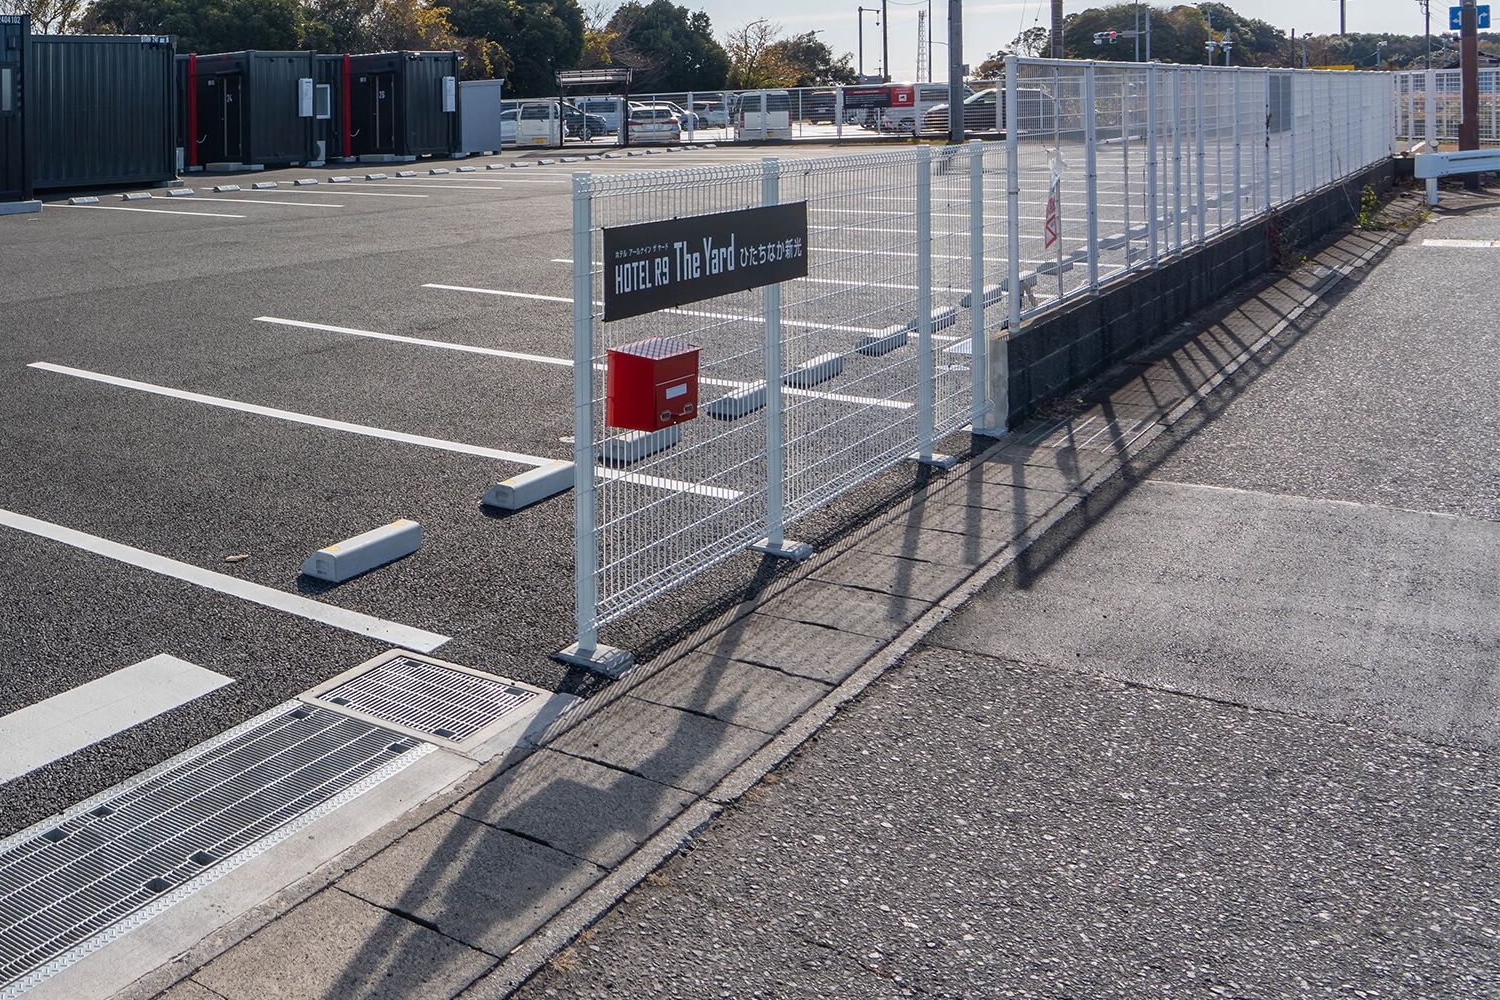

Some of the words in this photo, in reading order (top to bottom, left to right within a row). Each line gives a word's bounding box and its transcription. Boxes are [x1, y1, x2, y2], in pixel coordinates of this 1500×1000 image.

[615, 260, 652, 294] HOTEL
[654, 256, 669, 287] R9
[673, 240, 700, 282] The
[702, 232, 735, 276] Yard
[740, 237, 802, 267] ひたちなか新光
